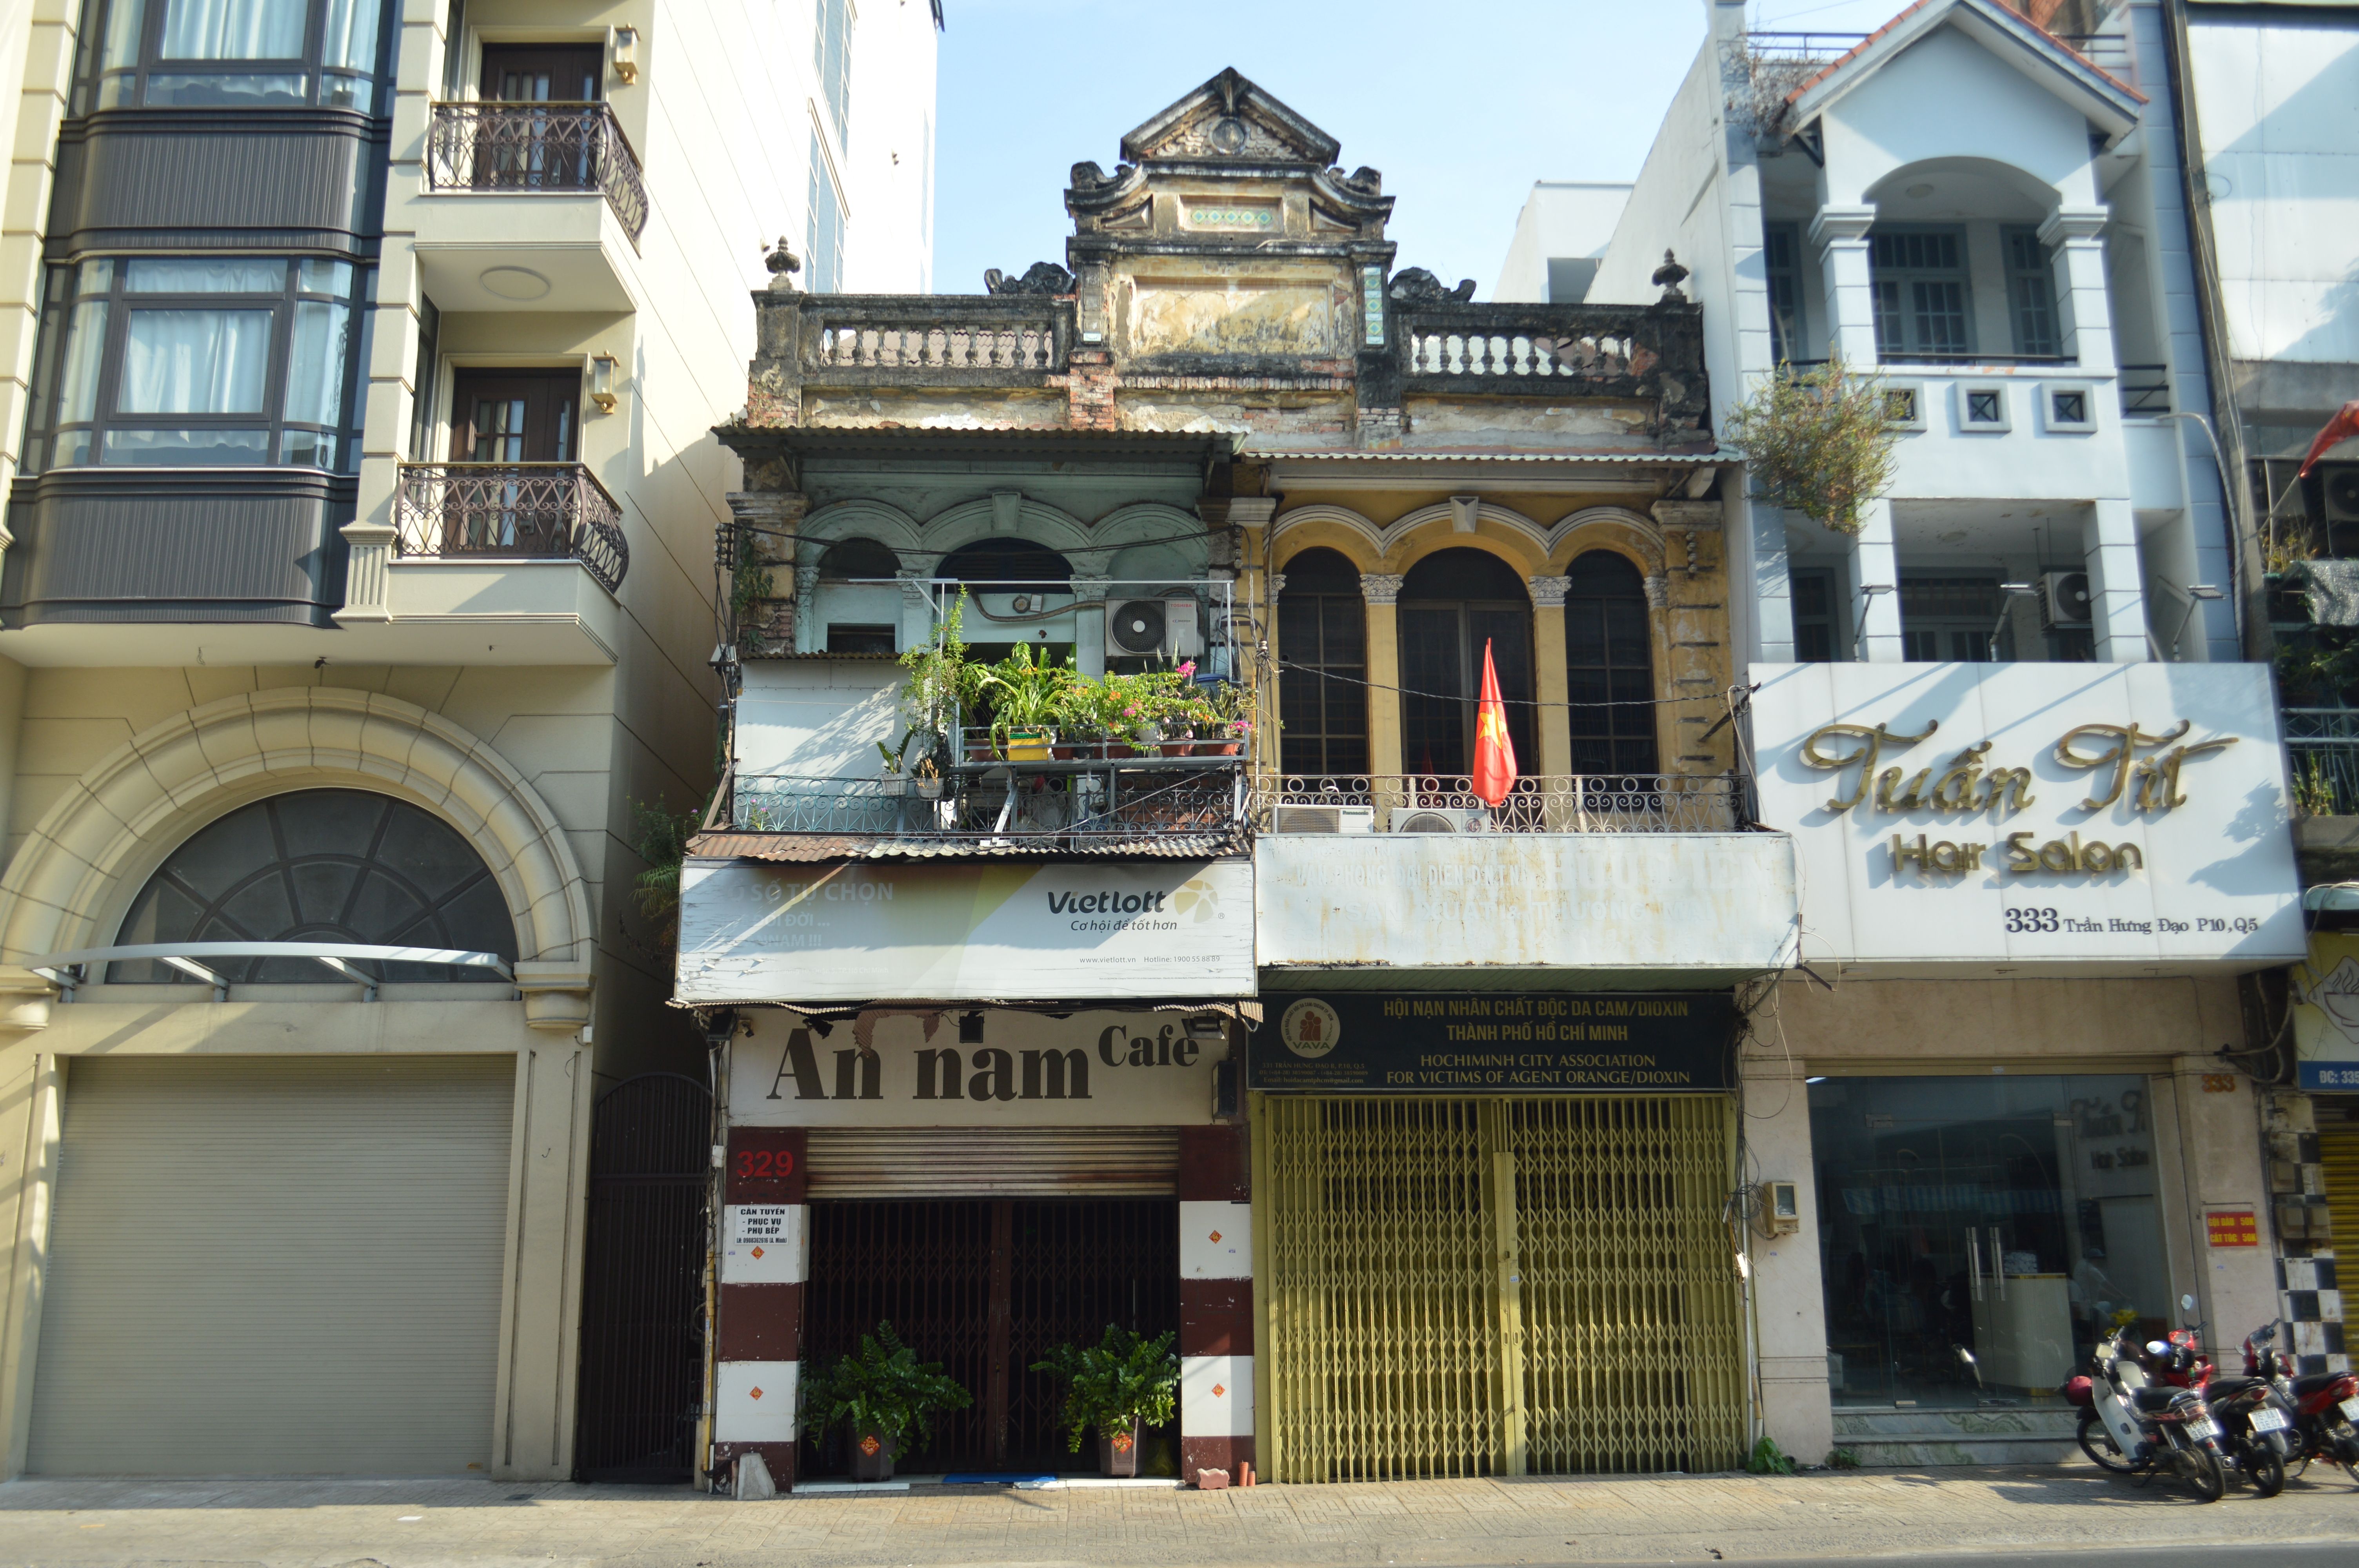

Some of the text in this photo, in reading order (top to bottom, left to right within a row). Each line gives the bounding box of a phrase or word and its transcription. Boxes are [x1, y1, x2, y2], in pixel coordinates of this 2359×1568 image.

[1891, 830, 2143, 873] Hair Salon
[825, 883, 893, 906] CHỌN
[1047, 891, 1166, 914] Vietlott
[1071, 918, 1178, 933] Cơ hội để tốt hơn
[2005, 907, 2059, 933] 333
[2063, 916, 2104, 933] Trần
[2108, 918, 2152, 935] Hưng
[2157, 918, 2189, 935] Đạo
[1384, 996, 1688, 1019] HỘI NẠN NHÂN CHẤT ĐỘC DA CAM/DIOXIN
[1447, 1020, 1628, 1040] THÀNH PHỐ HỒ CHÍ MINH
[1292, 1041, 1331, 1050] VAVA
[767, 1028, 1092, 1102] An nam
[1421, 1054, 1656, 1067] HOCHIMINH CITY ASSOCIATION
[1387, 1070, 1690, 1085] FOR VICTIMS OF AGENT ORANGE/DIOXIN
[2201, 1073, 2236, 1093] 333
[2319, 1070, 2339, 1084] ĐC:
[736, 1150, 794, 1177] 329
[747, 1218, 769, 1226] PHỤC
[771, 1218, 781, 1226] VỤ
[747, 1227, 763, 1235] PHỤ
[765, 1225, 780, 1234] BẾP
[2240, 1217, 2255, 1226] 50K
[2241, 1233, 2257, 1242] 50K
